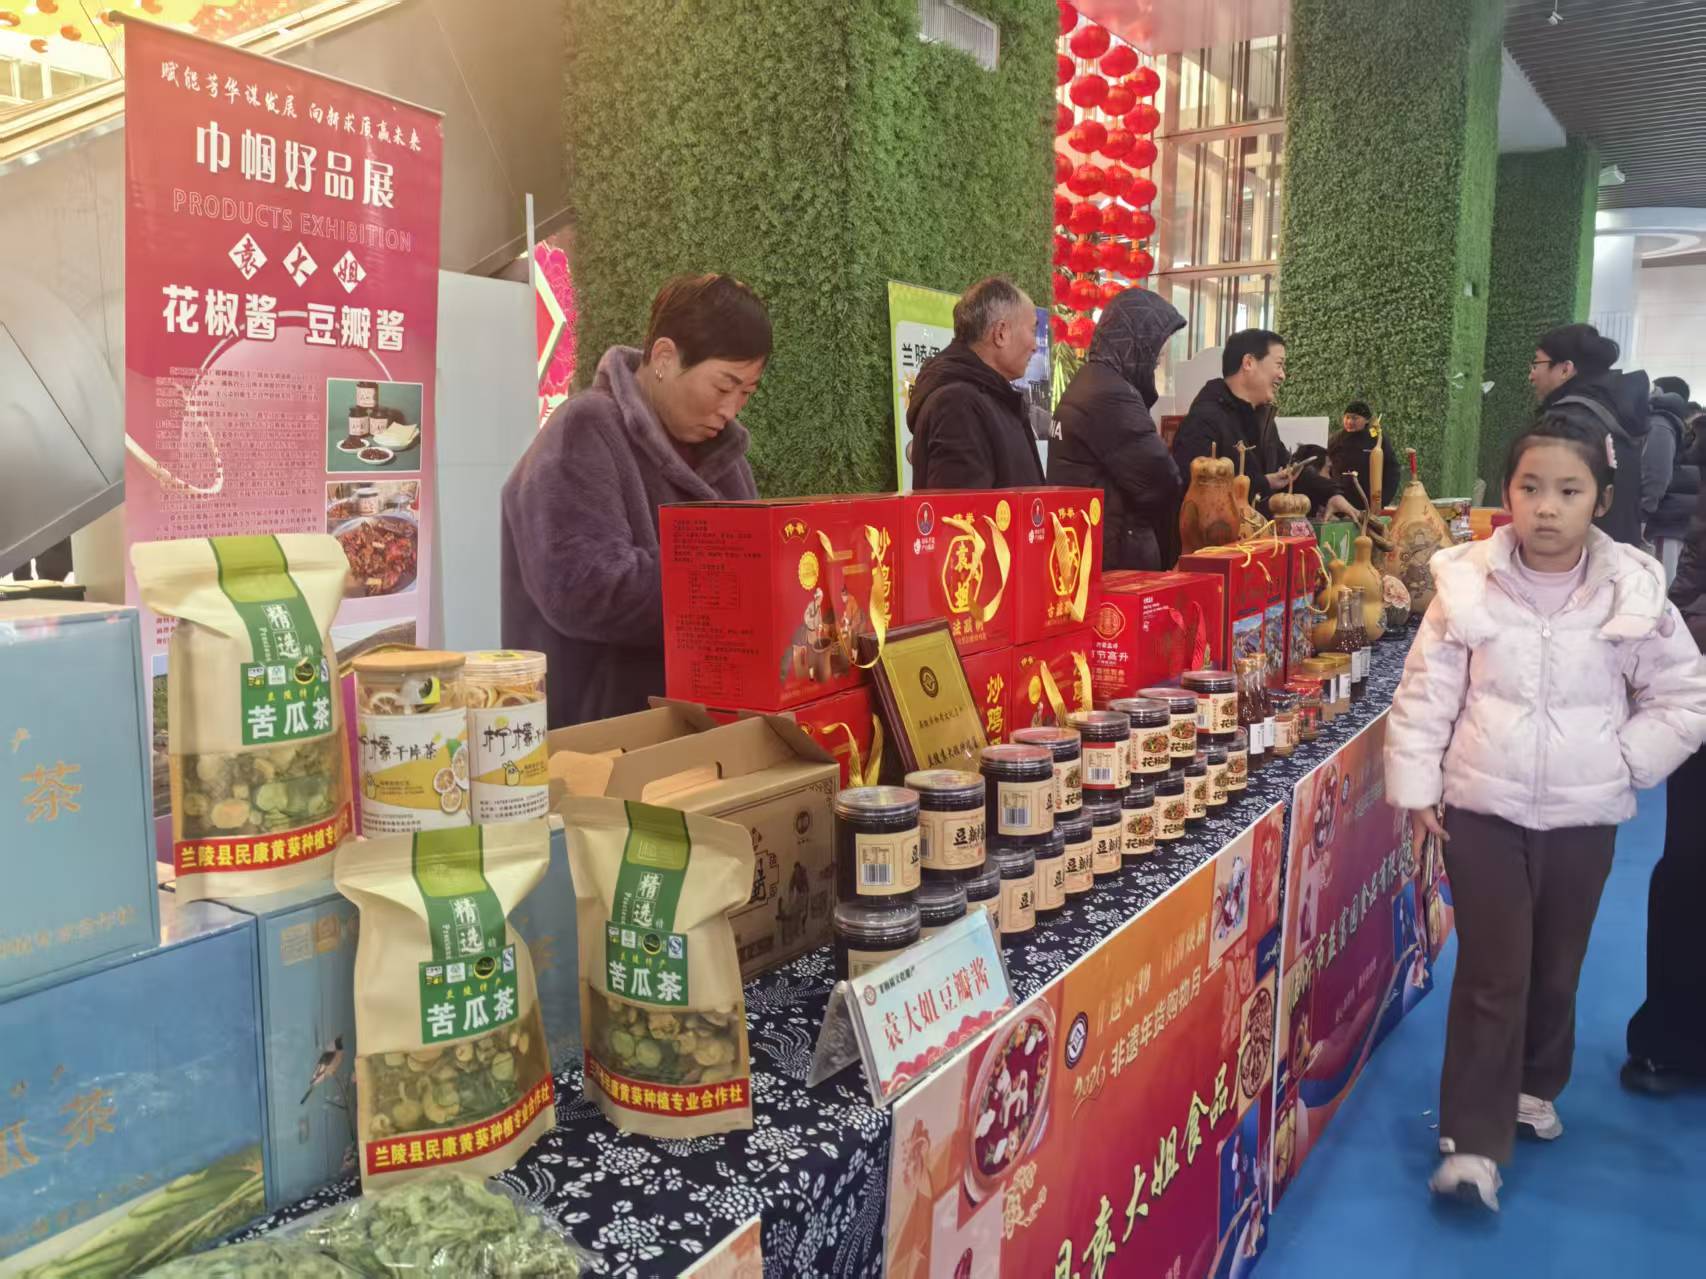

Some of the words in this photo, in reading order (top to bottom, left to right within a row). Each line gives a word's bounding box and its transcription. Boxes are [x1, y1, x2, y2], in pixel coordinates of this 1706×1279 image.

[161, 60, 297, 118] 赋能芳华谋发展
[308, 103, 422, 152] 向新求质赢未来
[195, 120, 394, 209] 巾帼好品展
[173, 188, 292, 231] PRODUCTS
[300, 212, 411, 252] EXHIBITION
[232, 236, 362, 286] 袁大姐
[162, 283, 277, 340] 花椒酱
[305, 302, 404, 350] 豆瓣酱
[1091, 650, 1129, 662] 节高升
[247, 696, 330, 739] 苦瓜茶
[17, 760, 85, 823] 茶
[426, 986, 515, 1037] 苦瓜茶
[608, 960, 682, 1002] 苦瓜茶
[884, 956, 990, 1052] 袁大姐豆瓣酱
[1110, 964, 1202, 1078] 非遗年货购物月
[375, 1083, 550, 1168] 兰陵县民康黄葵种植专业合作社
